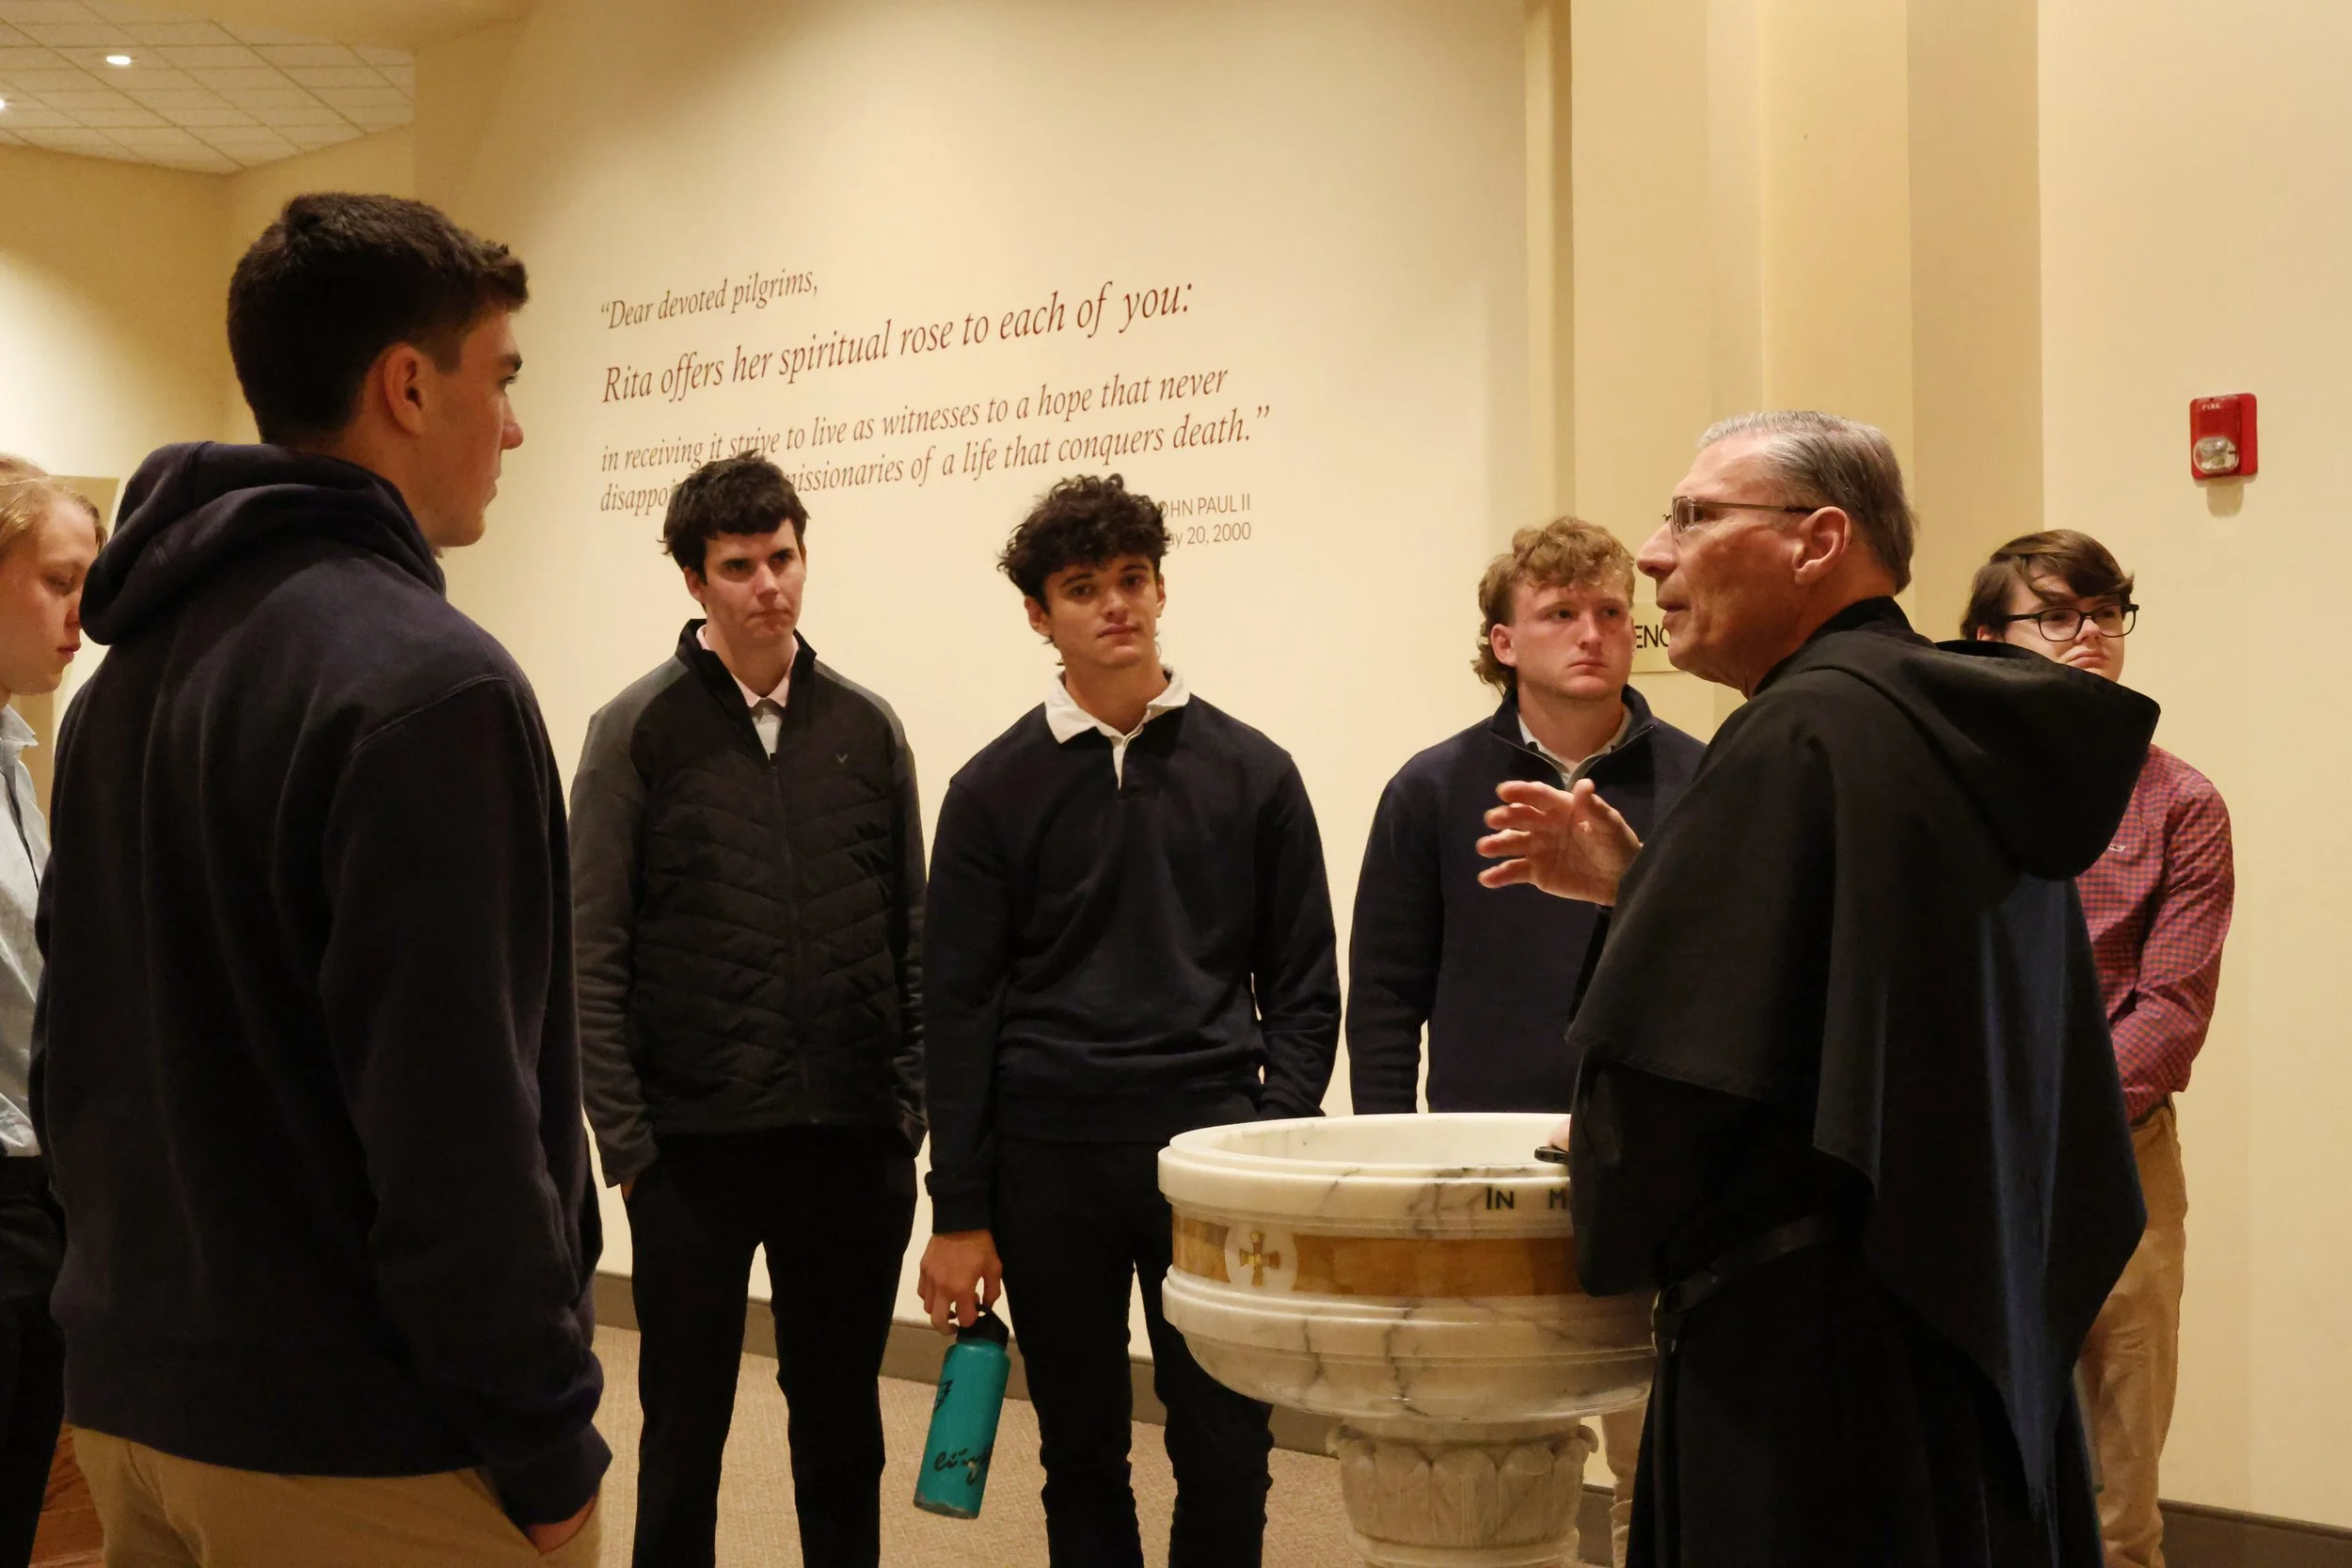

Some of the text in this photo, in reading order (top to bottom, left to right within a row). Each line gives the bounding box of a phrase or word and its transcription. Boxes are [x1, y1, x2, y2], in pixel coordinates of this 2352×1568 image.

[600, 268, 818, 329] “Dear devoted pilgrims,
[602, 280, 1193, 403] Rita offers her spiritual rose to each of you:
[601, 368, 1229, 472] in receiving it strive to live as witnesses to a hope that never
[600, 479, 675, 515] disappo
[911, 444, 936, 487] of
[942, 453, 955, 477] a
[962, 437, 995, 481] life
[1004, 435, 1052, 469] that
[1057, 426, 1165, 467] conquers
[1157, 499, 1193, 517] OHN
[1198, 495, 1238, 515] PAUL
[1167, 521, 1251, 549] ay 20, 2000
[1486, 1185, 1515, 1211] IN
